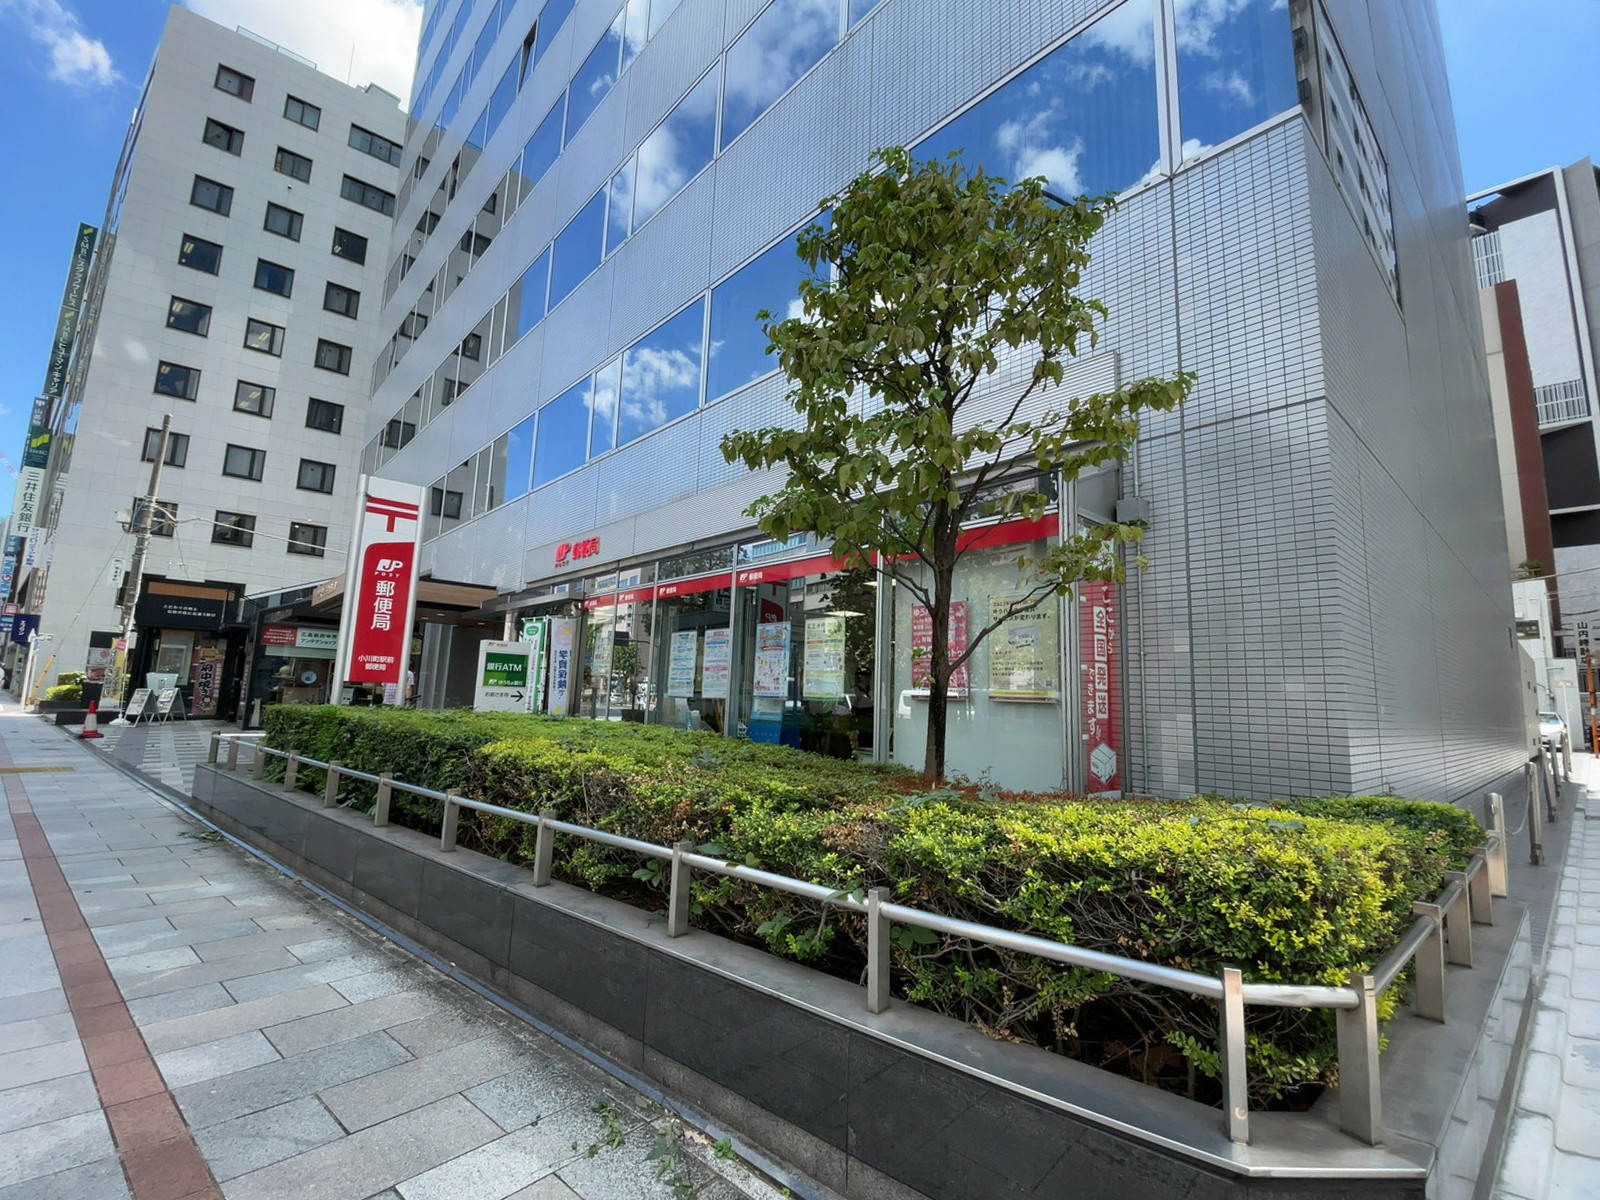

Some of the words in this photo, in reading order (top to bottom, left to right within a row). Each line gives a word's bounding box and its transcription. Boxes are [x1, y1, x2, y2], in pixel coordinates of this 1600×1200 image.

[17, 471, 40, 533] 三井住友銀行
[572, 536, 600, 561] 郵便局
[0, 560, 14, 594] KINGRUN
[377, 558, 403, 572] JP
[371, 580, 396, 631] 郵便局
[358, 654, 395, 664] 小川町駅前
[365, 663, 387, 671] 郵便局
[486, 662, 522, 672] 銀行ATM
[1094, 608, 1107, 717] 全国発送
